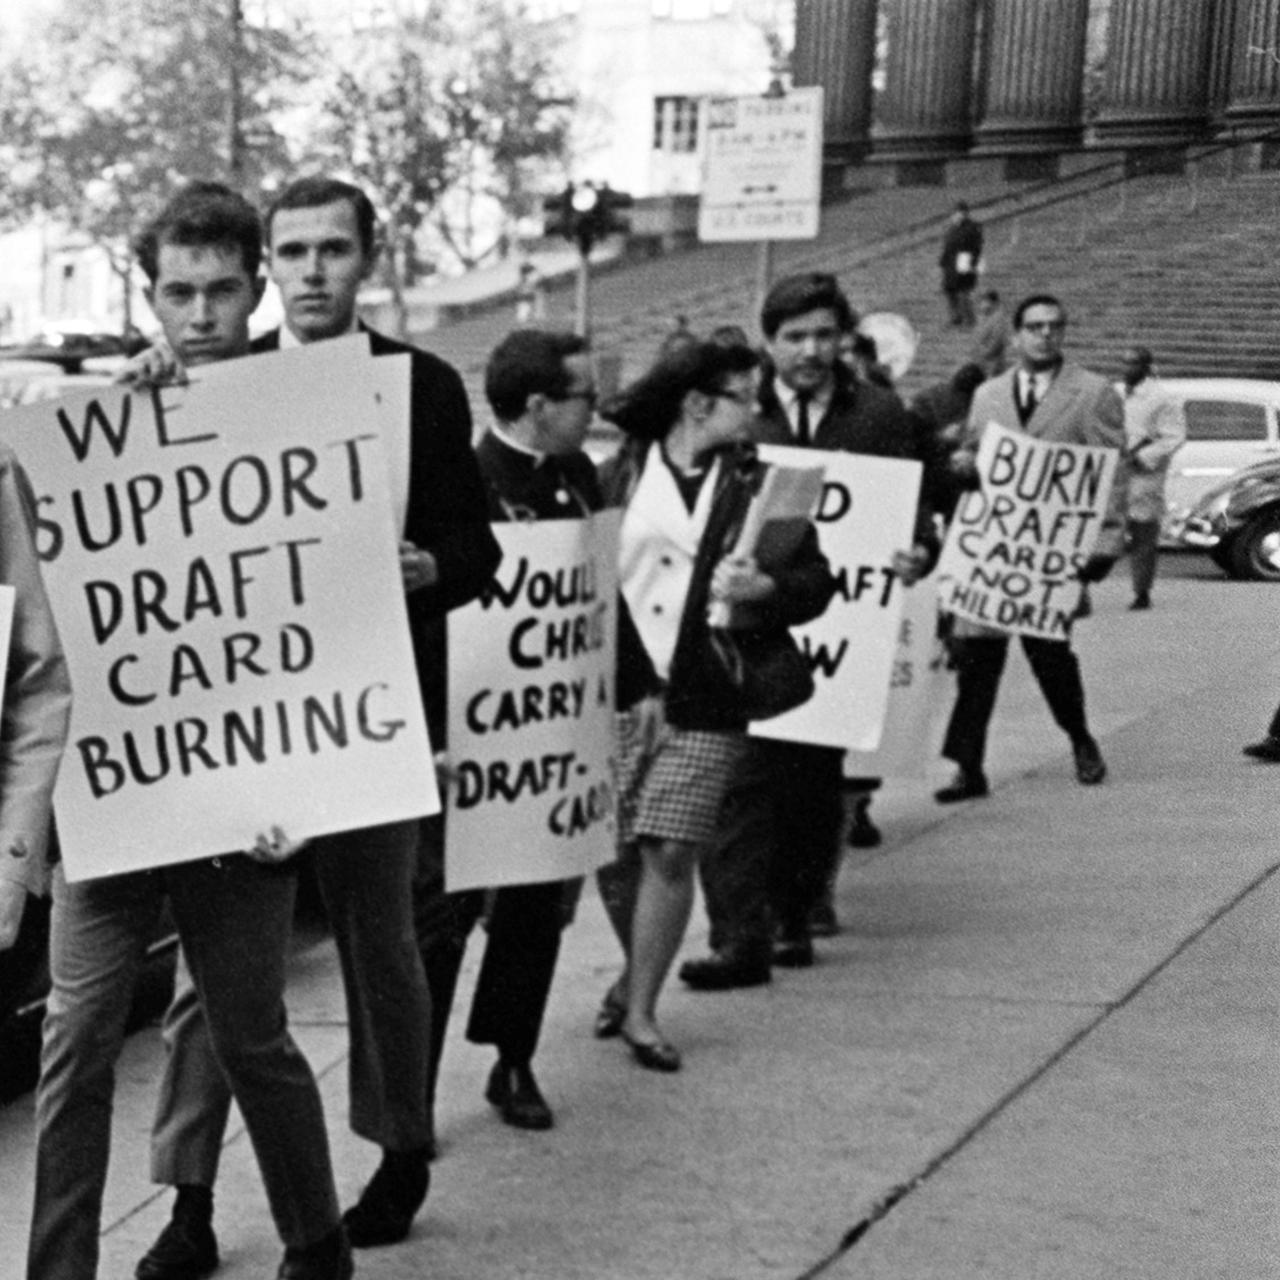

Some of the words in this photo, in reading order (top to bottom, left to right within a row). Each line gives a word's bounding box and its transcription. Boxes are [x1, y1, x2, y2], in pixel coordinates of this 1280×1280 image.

[56, 379, 220, 463] WE
[36, 433, 378, 561] SUPPORT
[989, 437, 1106, 508] BURN
[959, 490, 1097, 548] DRAFT
[834, 566, 896, 608] AFT
[958, 530, 1085, 580] CARDS
[971, 566, 1065, 609] NOT
[84, 537, 322, 646] DRAFT
[107, 623, 315, 707] CARD
[75, 682, 407, 799] BURNING
[466, 677, 587, 735] CARRY
